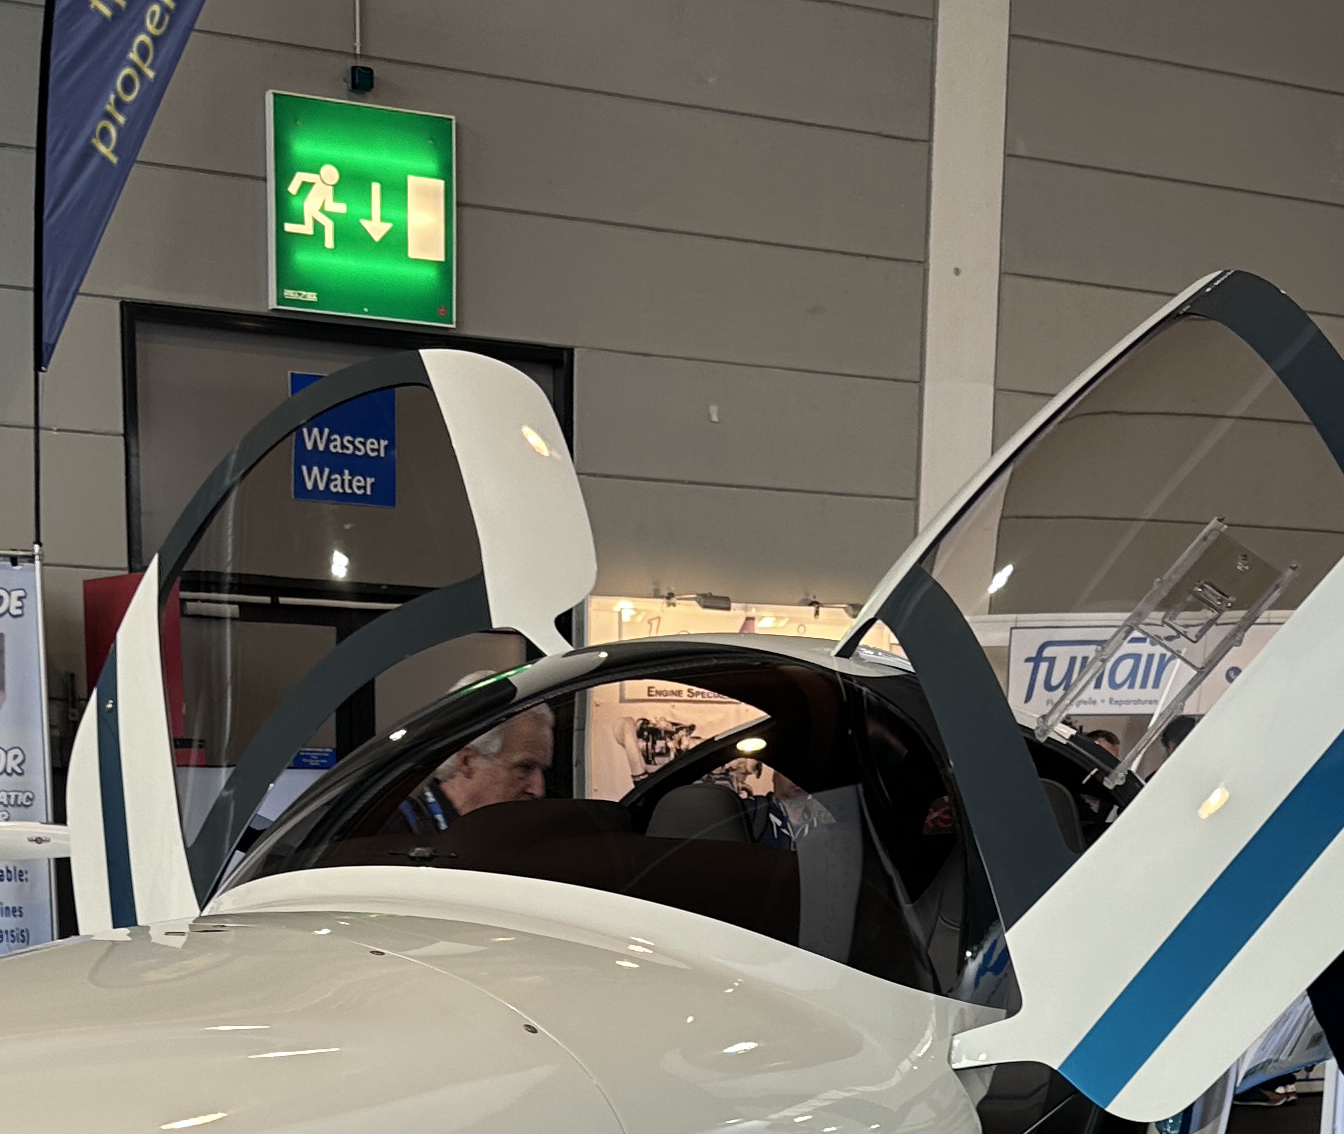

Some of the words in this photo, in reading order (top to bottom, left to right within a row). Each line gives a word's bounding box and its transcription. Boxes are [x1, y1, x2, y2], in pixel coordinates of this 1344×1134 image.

[91, 0, 176, 166] prope
[302, 427, 389, 457] Wasser
[301, 465, 375, 495] Water
